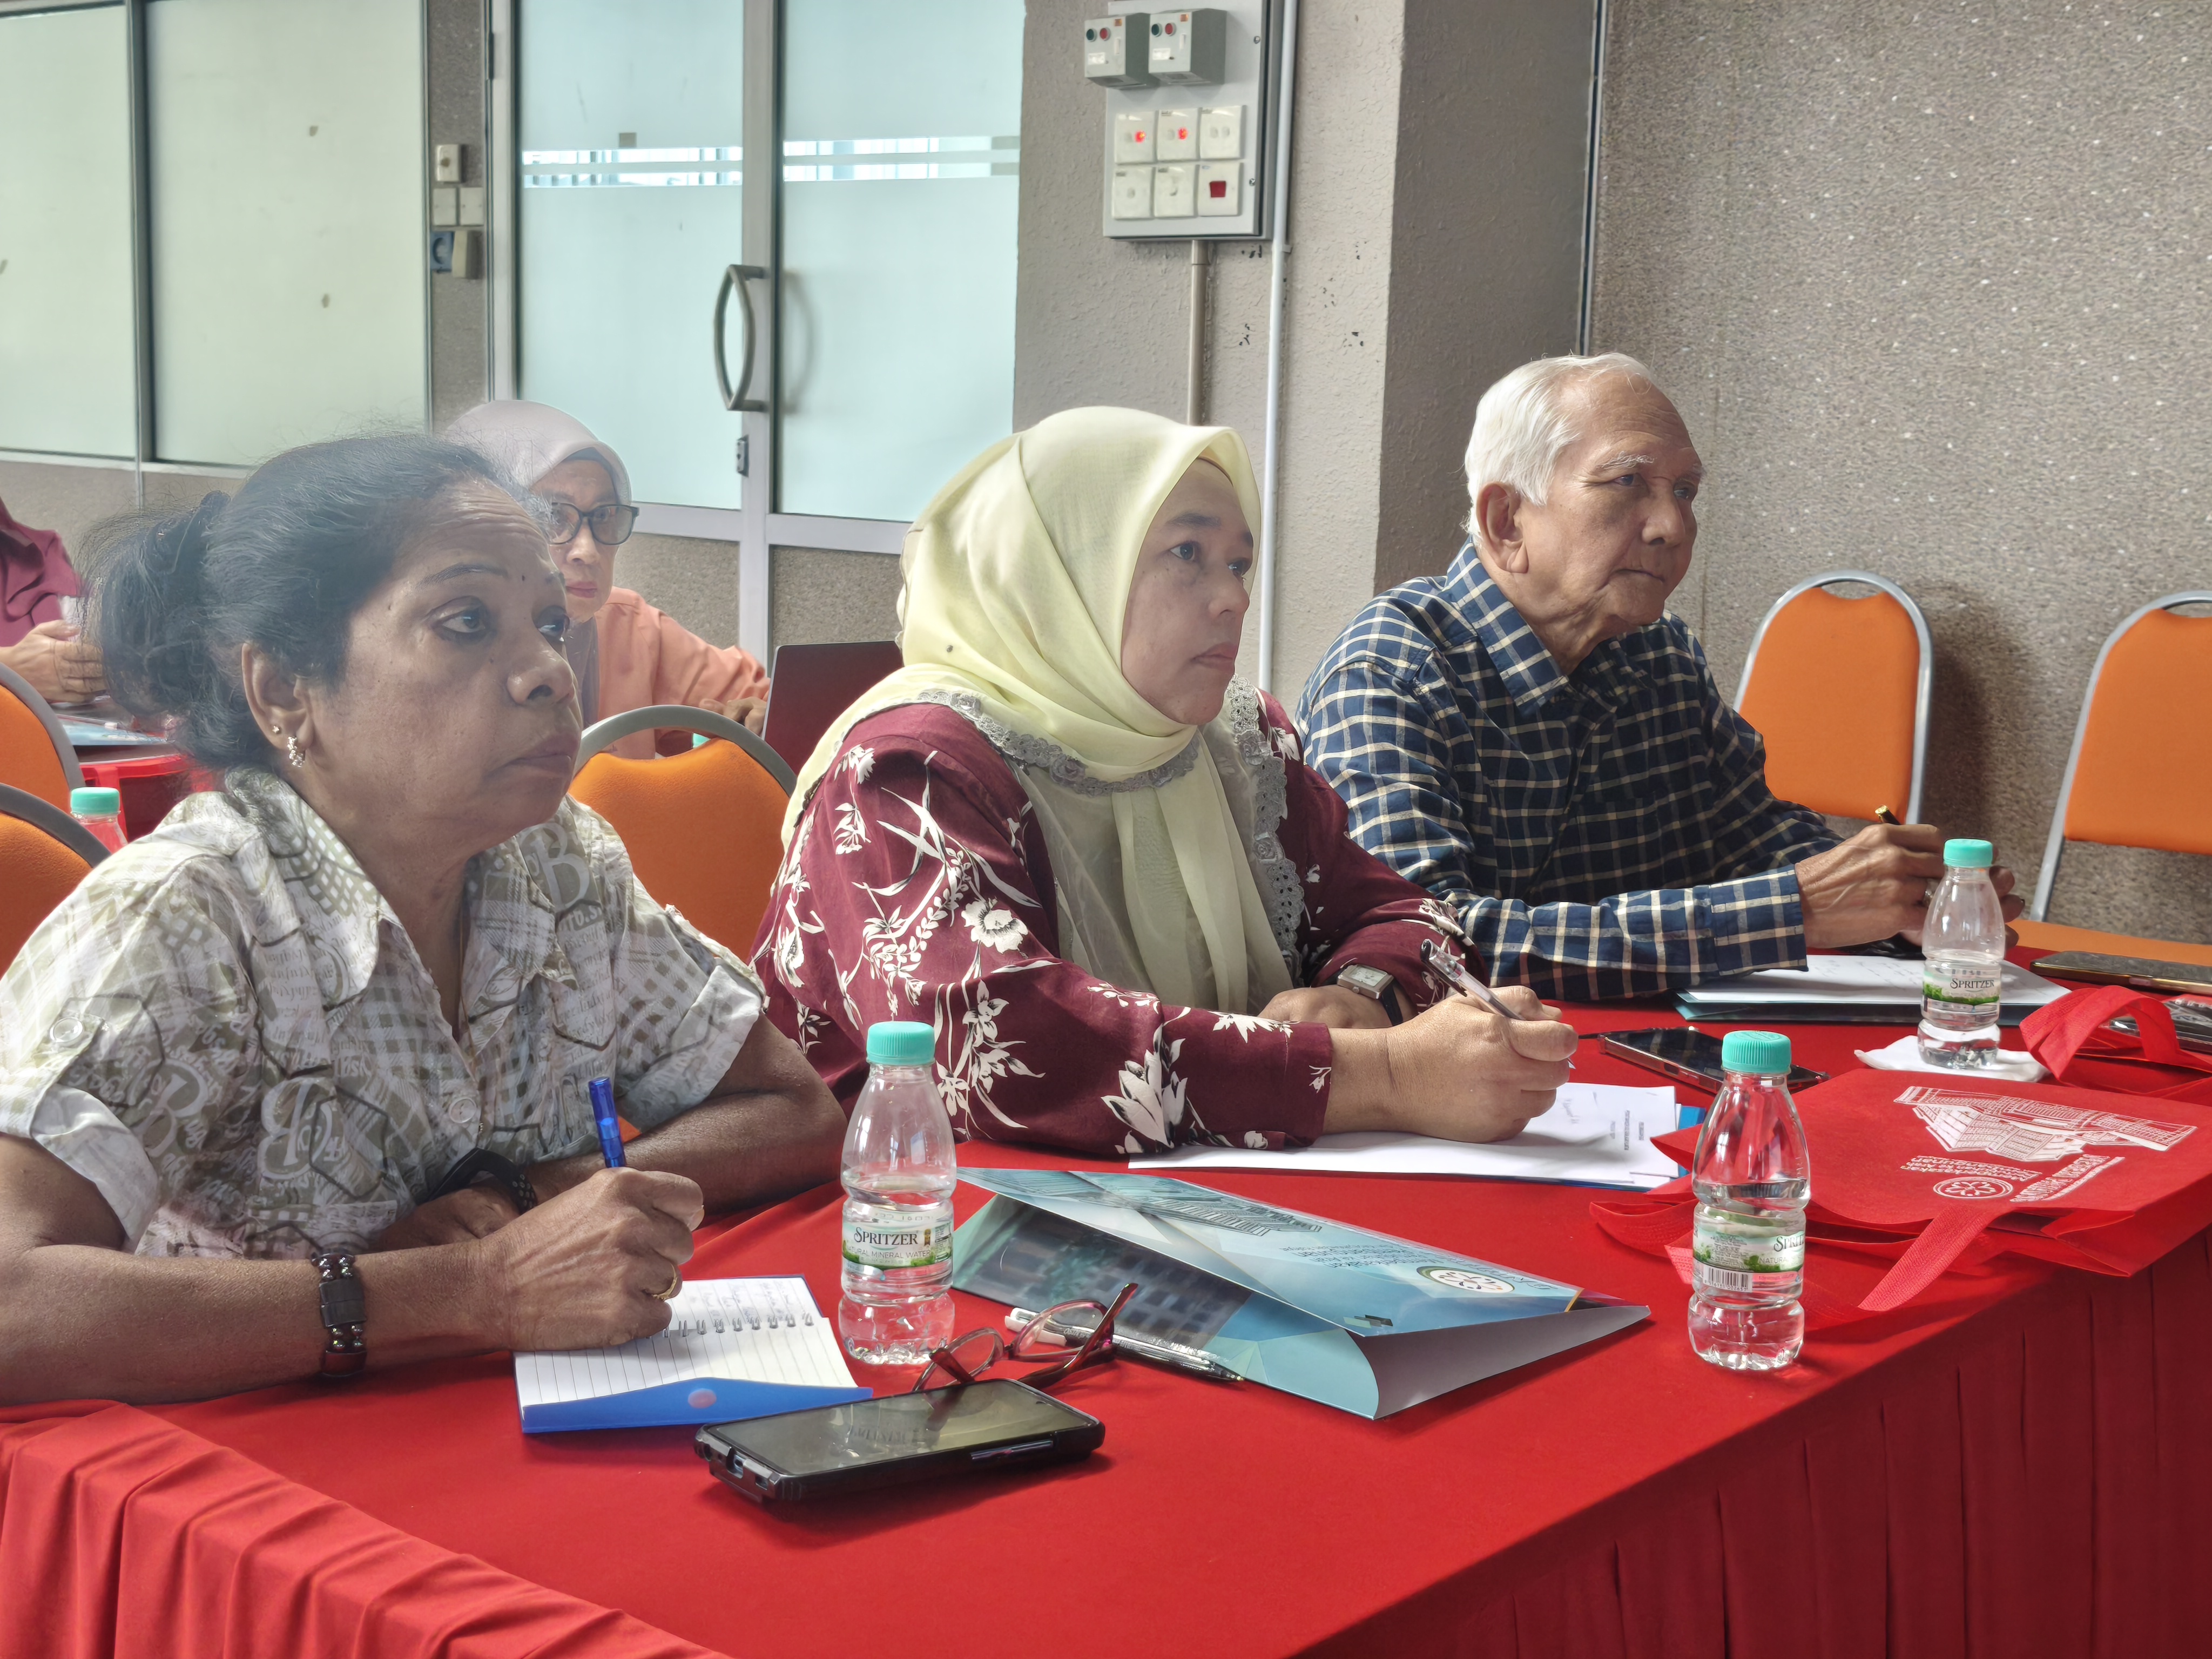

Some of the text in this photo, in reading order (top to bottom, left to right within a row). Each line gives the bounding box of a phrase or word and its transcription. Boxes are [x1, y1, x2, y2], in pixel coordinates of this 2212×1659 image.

[1950, 978, 1994, 989] SPRITZER
[854, 1227, 919, 1245] SPRITZER
[871, 1251, 903, 1259] MINERAL
[906, 1249, 931, 1258] WATER
[1291, 1249, 1418, 1258] Pembangunan
[1323, 1258, 1444, 1269] Memperkasakan
